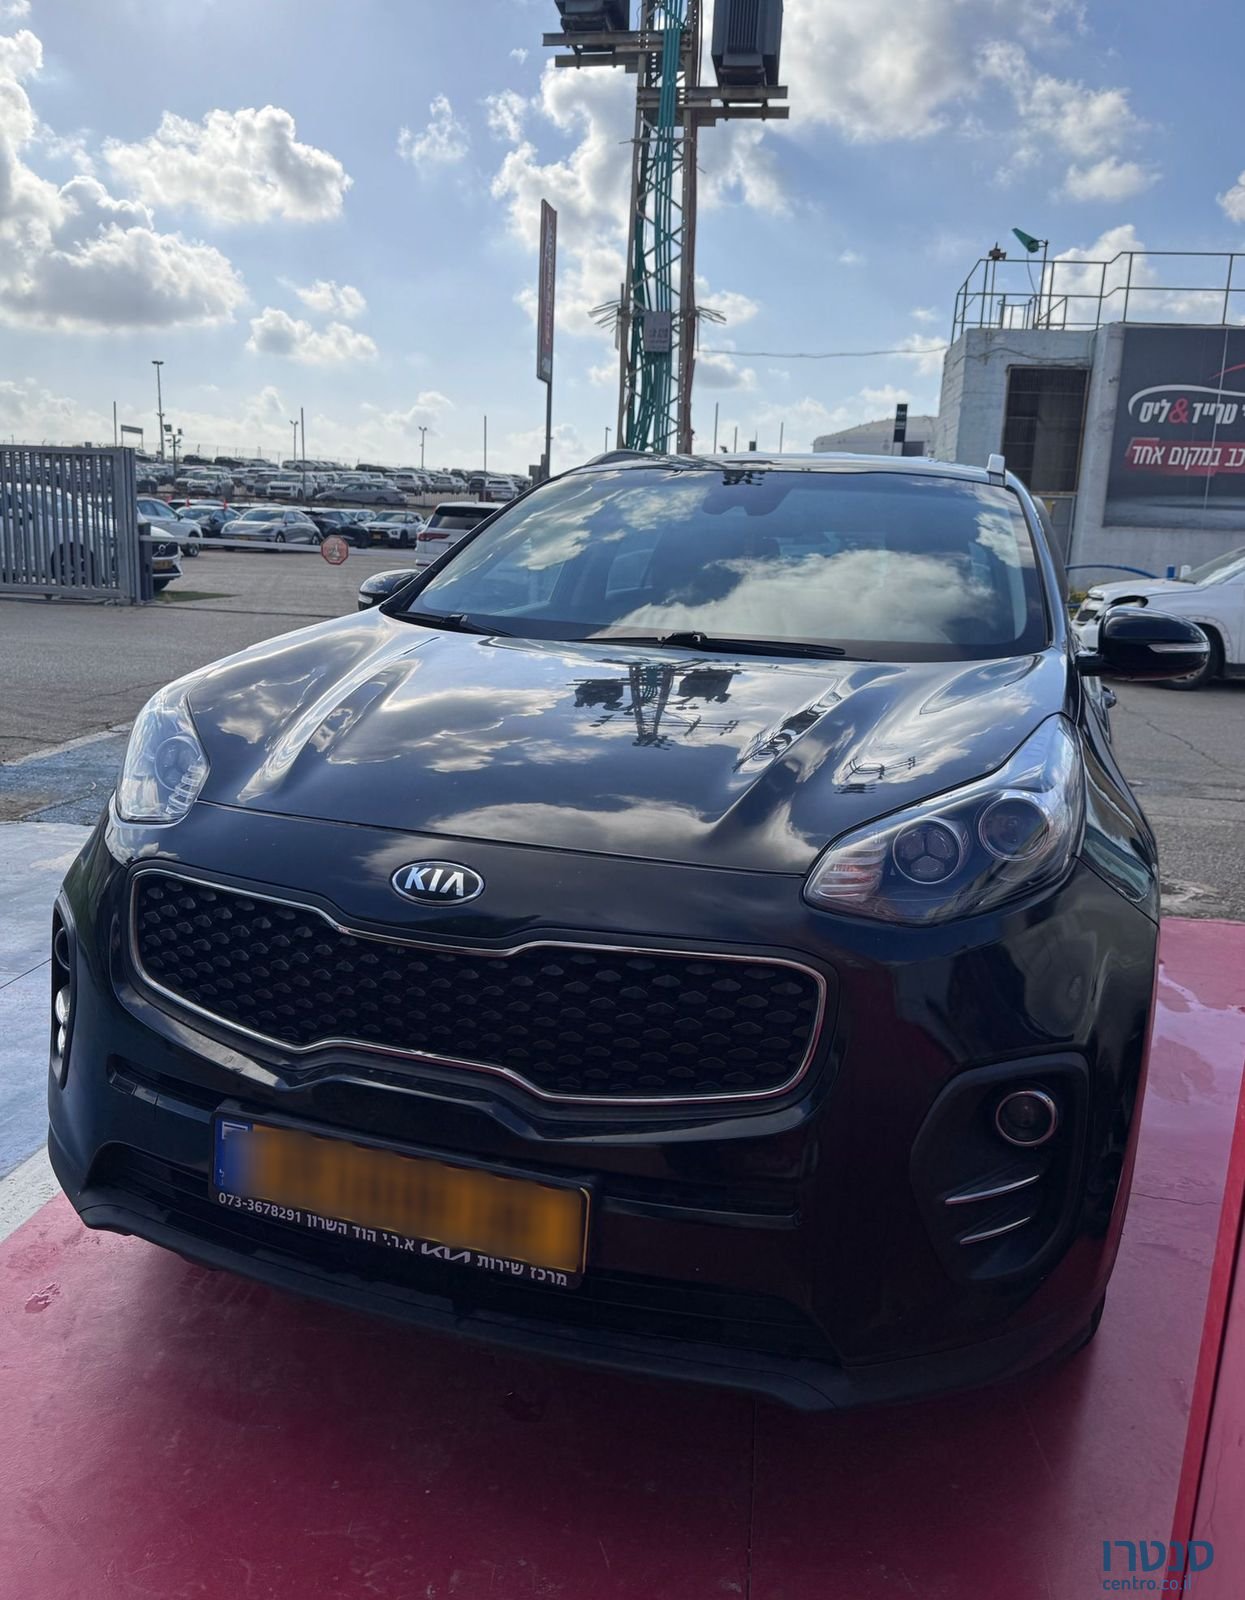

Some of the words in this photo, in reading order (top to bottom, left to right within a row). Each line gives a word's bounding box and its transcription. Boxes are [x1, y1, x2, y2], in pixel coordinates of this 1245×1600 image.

[1132, 446, 1166, 465] אחד
[1168, 446, 1222, 471] במקום
[404, 866, 464, 896] KIA
[218, 1192, 301, 1223] 073-3678291
[307, 1213, 348, 1235] השרון
[352, 1225, 377, 1243] הוד
[421, 1242, 471, 1264] KIA
[477, 1254, 524, 1276] שירות
[530, 1266, 567, 1286] מרכז
